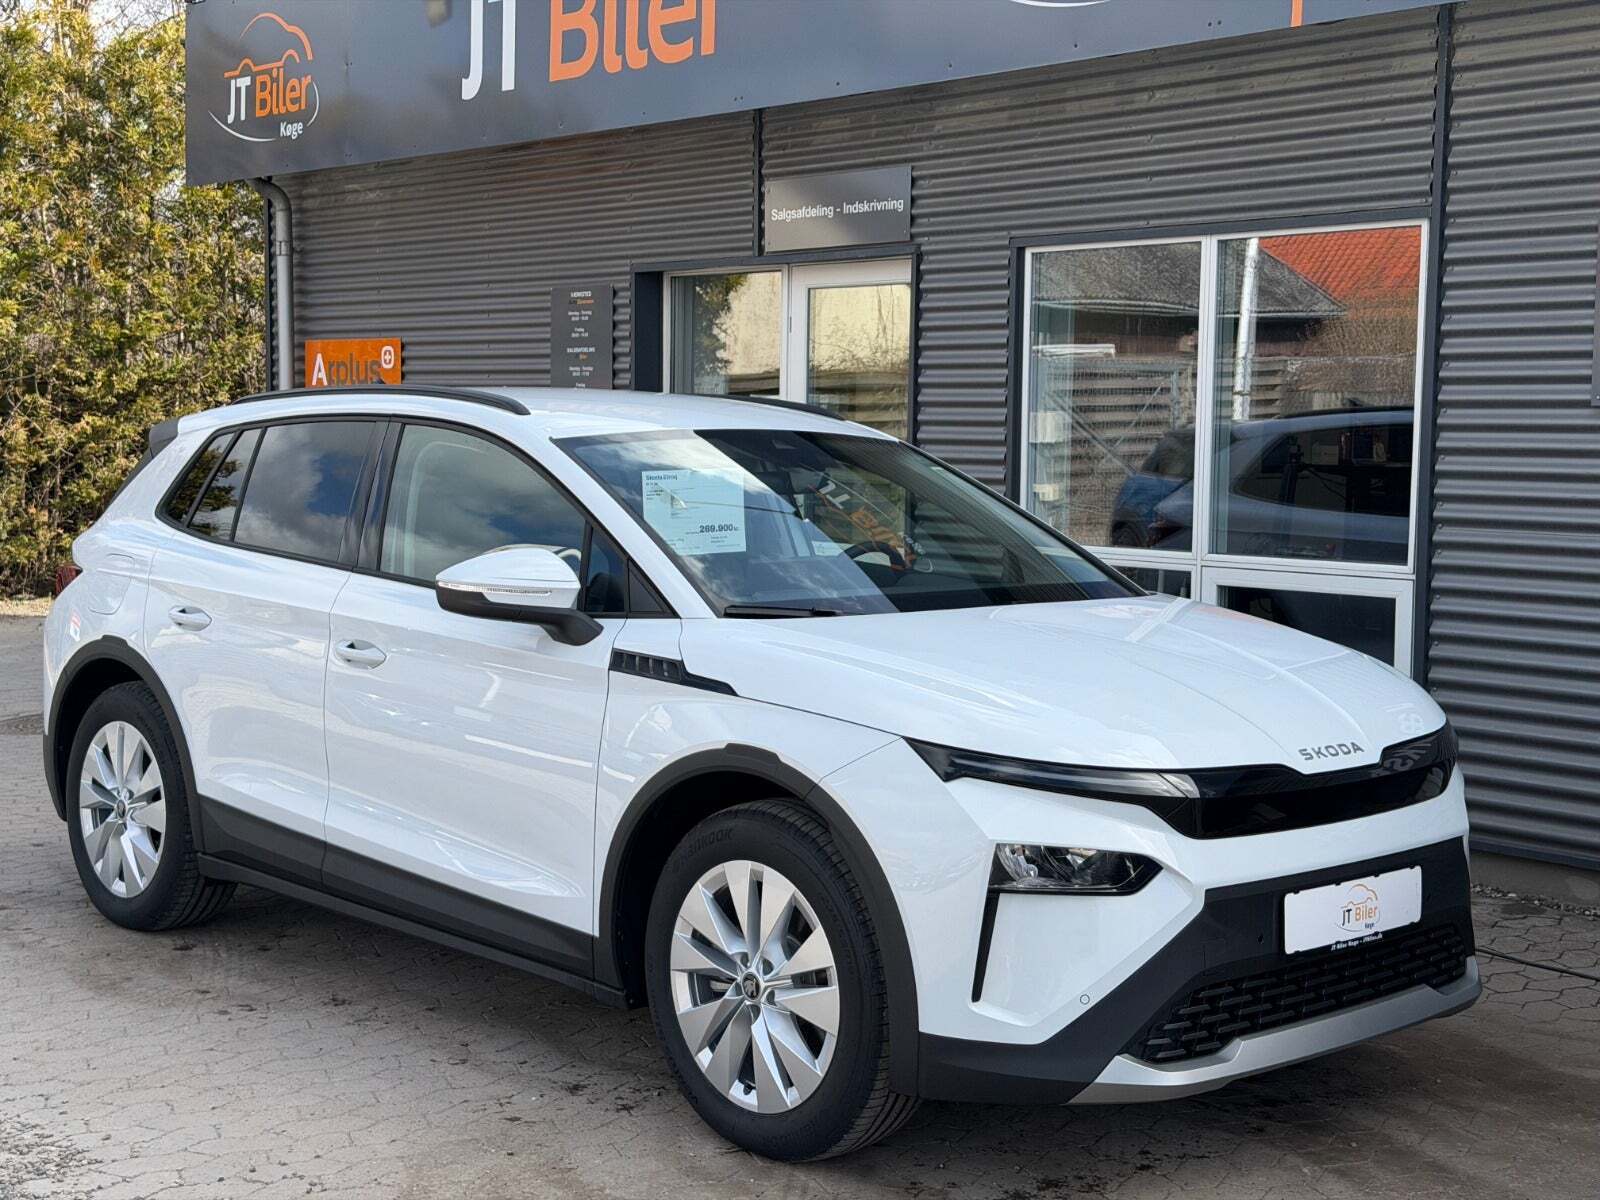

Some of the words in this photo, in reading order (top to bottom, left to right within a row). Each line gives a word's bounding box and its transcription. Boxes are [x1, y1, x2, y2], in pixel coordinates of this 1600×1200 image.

[227, 76, 251, 124] JT
[255, 67, 312, 117] Biler
[280, 121, 304, 140] Køge
[771, 203, 834, 222] Salgsafdeling
[843, 198, 904, 214] Indskrivning
[699, 523, 734, 534] 269.900
[1342, 908, 1353, 926] JT
[1355, 904, 1378, 921] Biler
